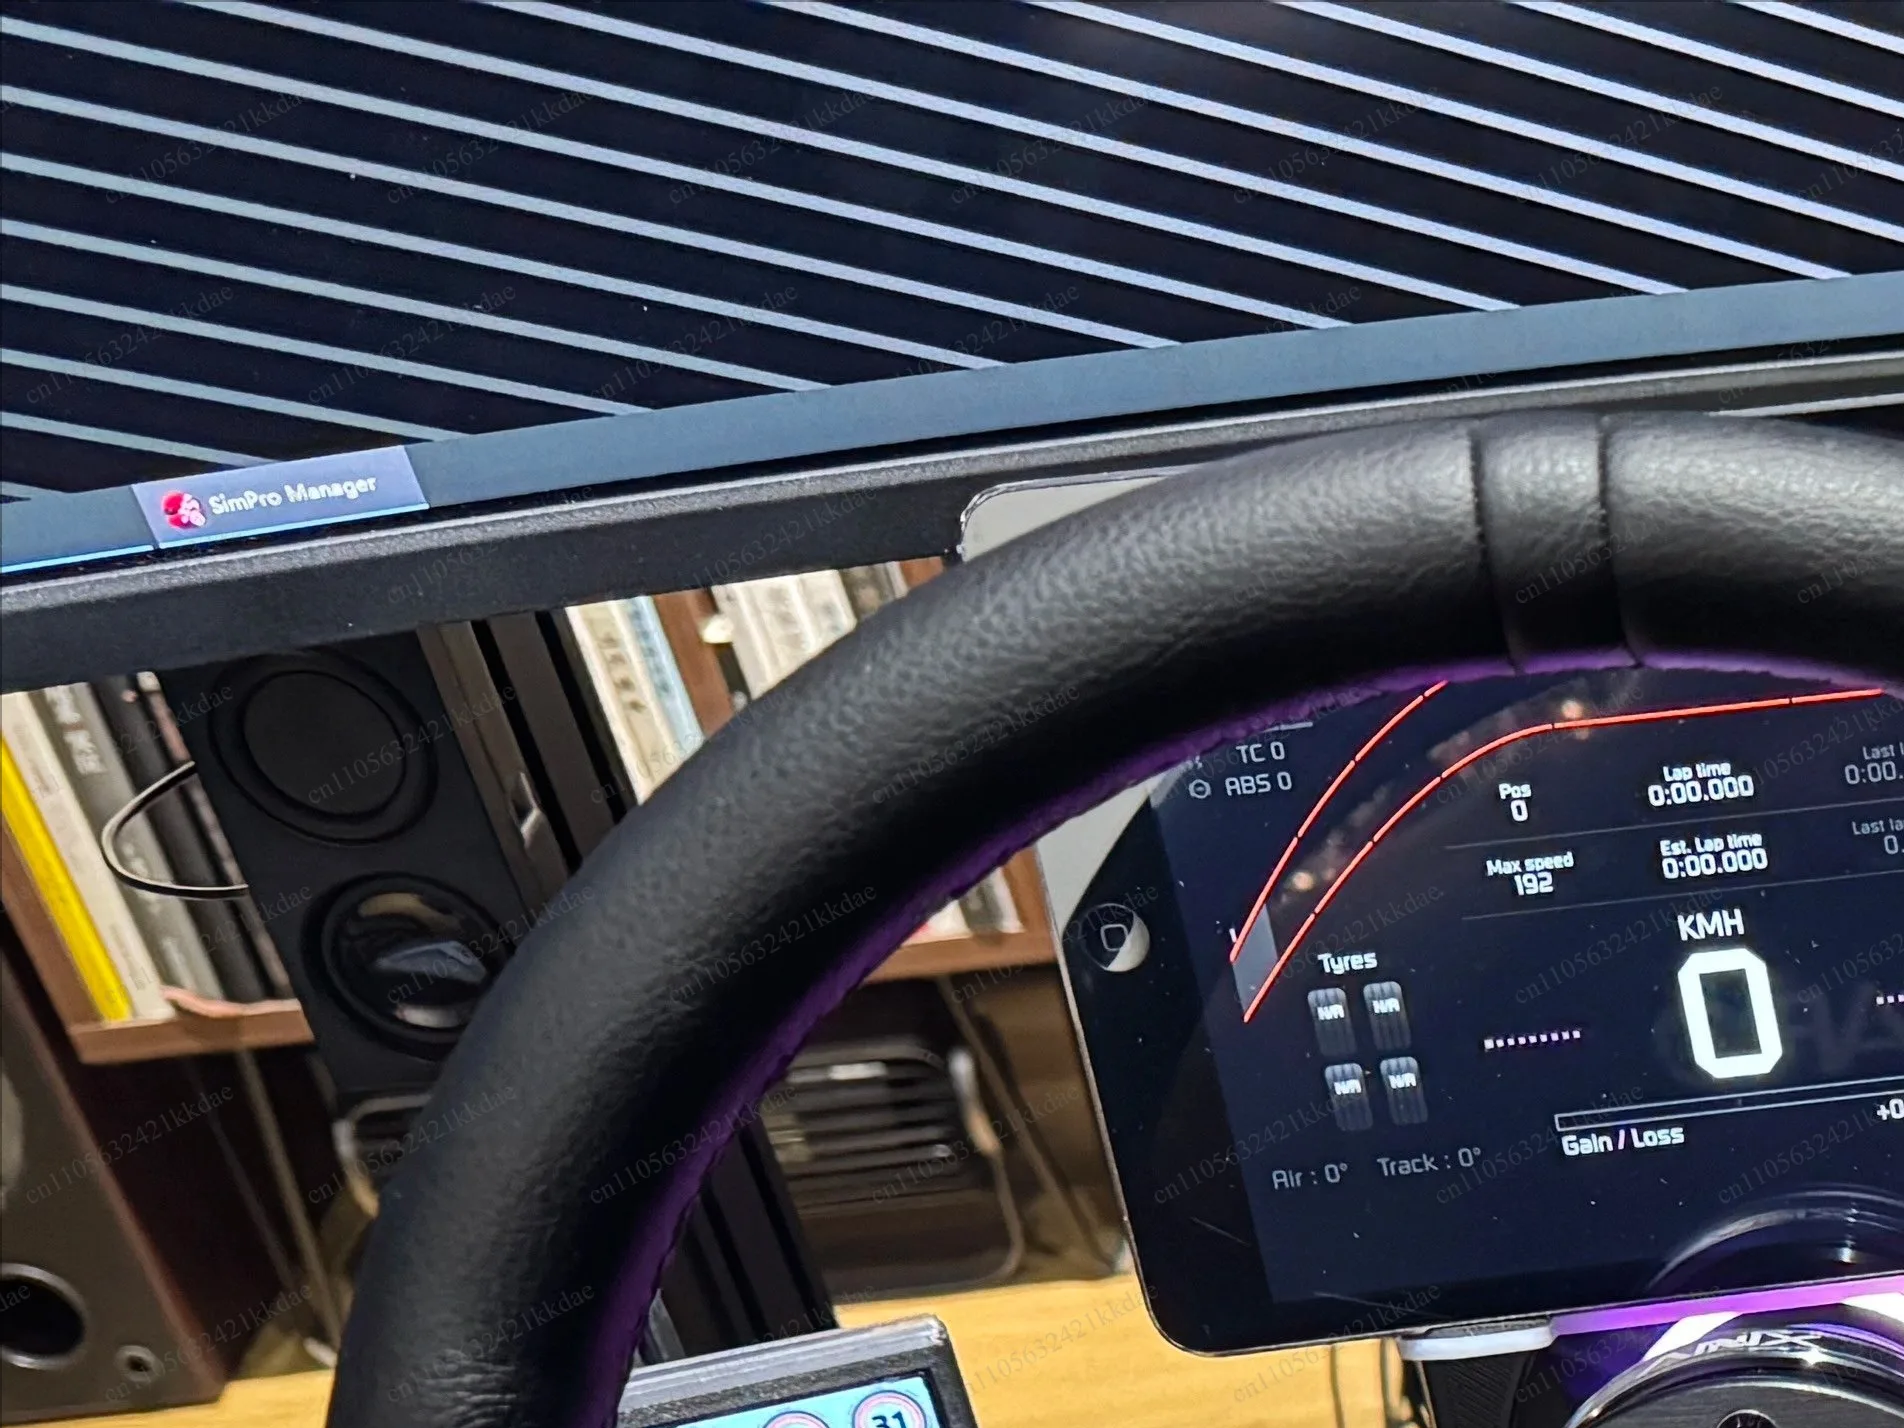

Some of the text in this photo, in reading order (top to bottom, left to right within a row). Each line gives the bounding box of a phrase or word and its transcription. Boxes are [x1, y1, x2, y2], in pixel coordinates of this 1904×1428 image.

[208, 477, 377, 515] SimPro Manager
[1235, 741, 1286, 764] TC 0
[1862, 744, 1894, 760] Last
[1225, 771, 1293, 796] ABS 0
[1662, 761, 1732, 782] Lap time
[1499, 783, 1532, 800] Pos
[1647, 775, 1755, 807] 0:00.000
[1509, 799, 1529, 822] 0
[1851, 819, 1885, 836] Last
[1659, 832, 1763, 857] Est. Lap time
[1485, 851, 1575, 876] Max speed
[1661, 847, 1769, 880] 0:00.000
[1513, 872, 1555, 896] 192
[1677, 908, 1745, 942] KMH
[1317, 952, 1378, 975] Tyres
[1677, 947, 1783, 1079] 0
[1561, 1130, 1613, 1157] Gain
[1633, 1125, 1685, 1149] Loss
[1377, 1152, 1439, 1177] Track
[1271, 1169, 1304, 1190] Air
